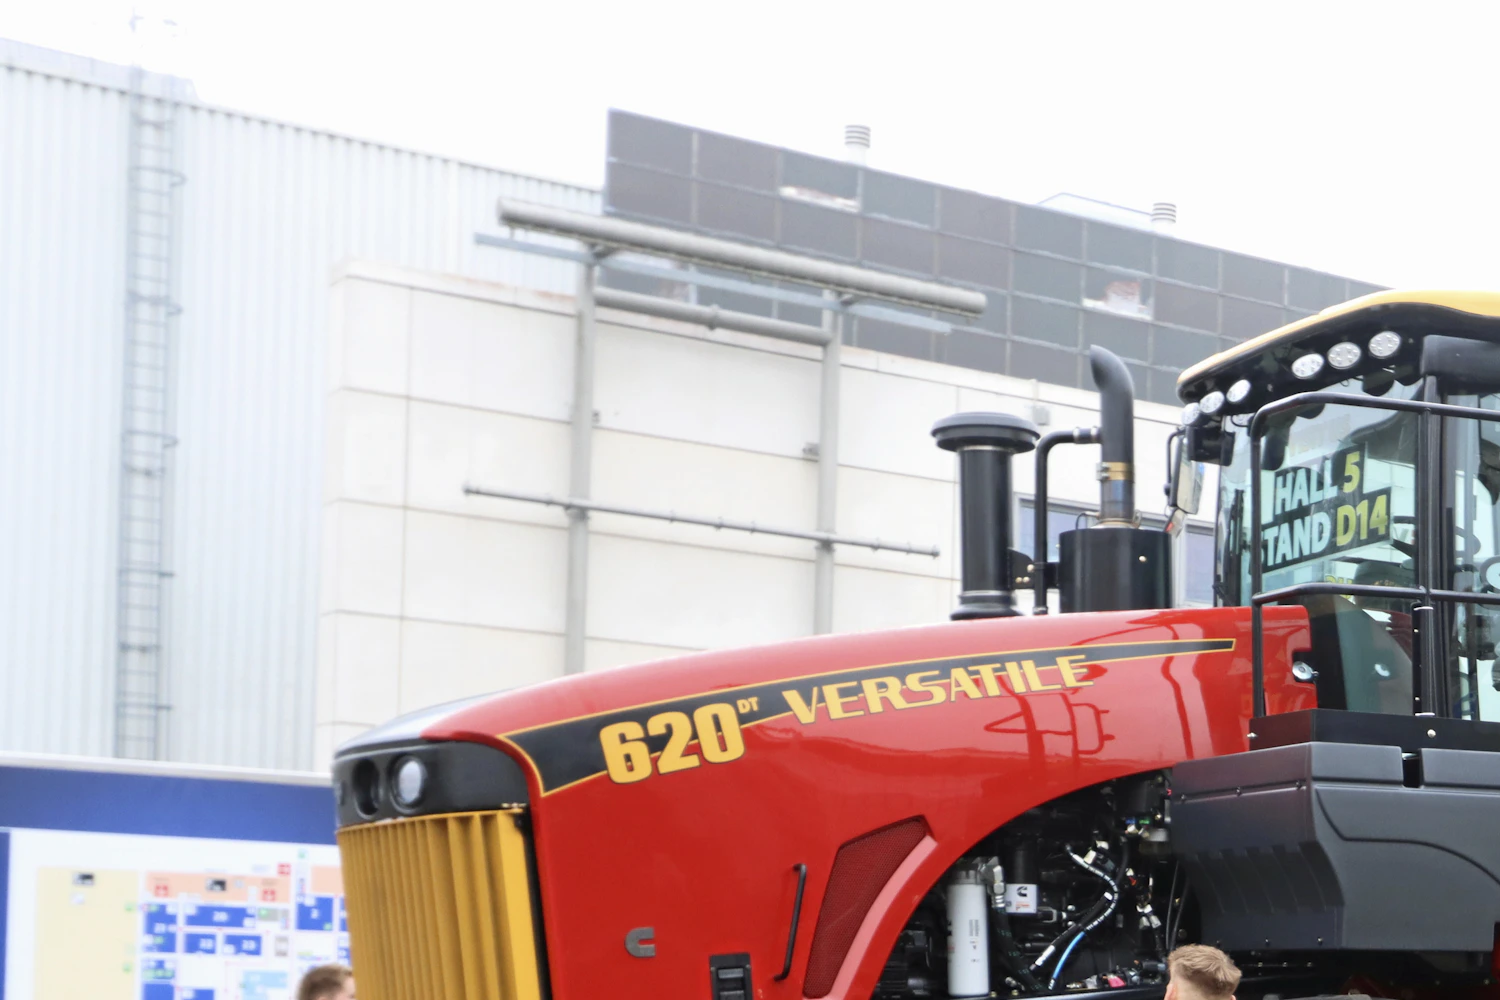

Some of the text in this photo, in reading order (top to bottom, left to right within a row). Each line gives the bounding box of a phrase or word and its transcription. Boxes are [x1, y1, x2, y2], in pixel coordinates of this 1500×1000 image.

[1275, 451, 1360, 515] HALL 5
[1260, 494, 1388, 567] TAND D14
[600, 655, 1094, 784] 620 DT VERSATILE
